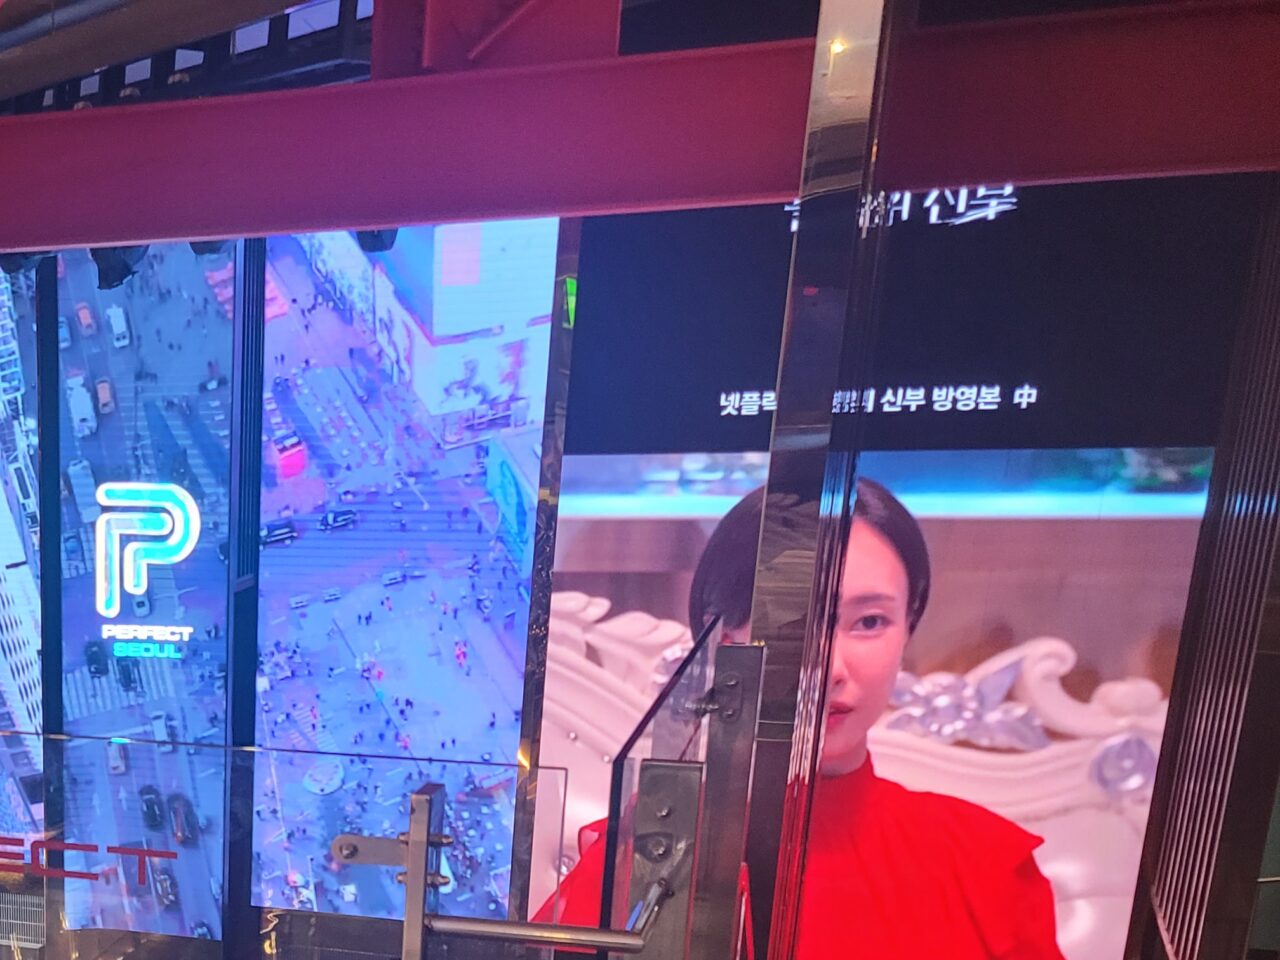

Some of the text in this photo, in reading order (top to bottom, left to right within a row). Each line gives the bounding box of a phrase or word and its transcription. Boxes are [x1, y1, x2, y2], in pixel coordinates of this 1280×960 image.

[880, 387, 926, 412] 신부
[932, 385, 1001, 411] 방영본
[1014, 384, 1037, 409] 中
[101, 625, 194, 641] PERFECT
[113, 642, 183, 658] SEOUL
